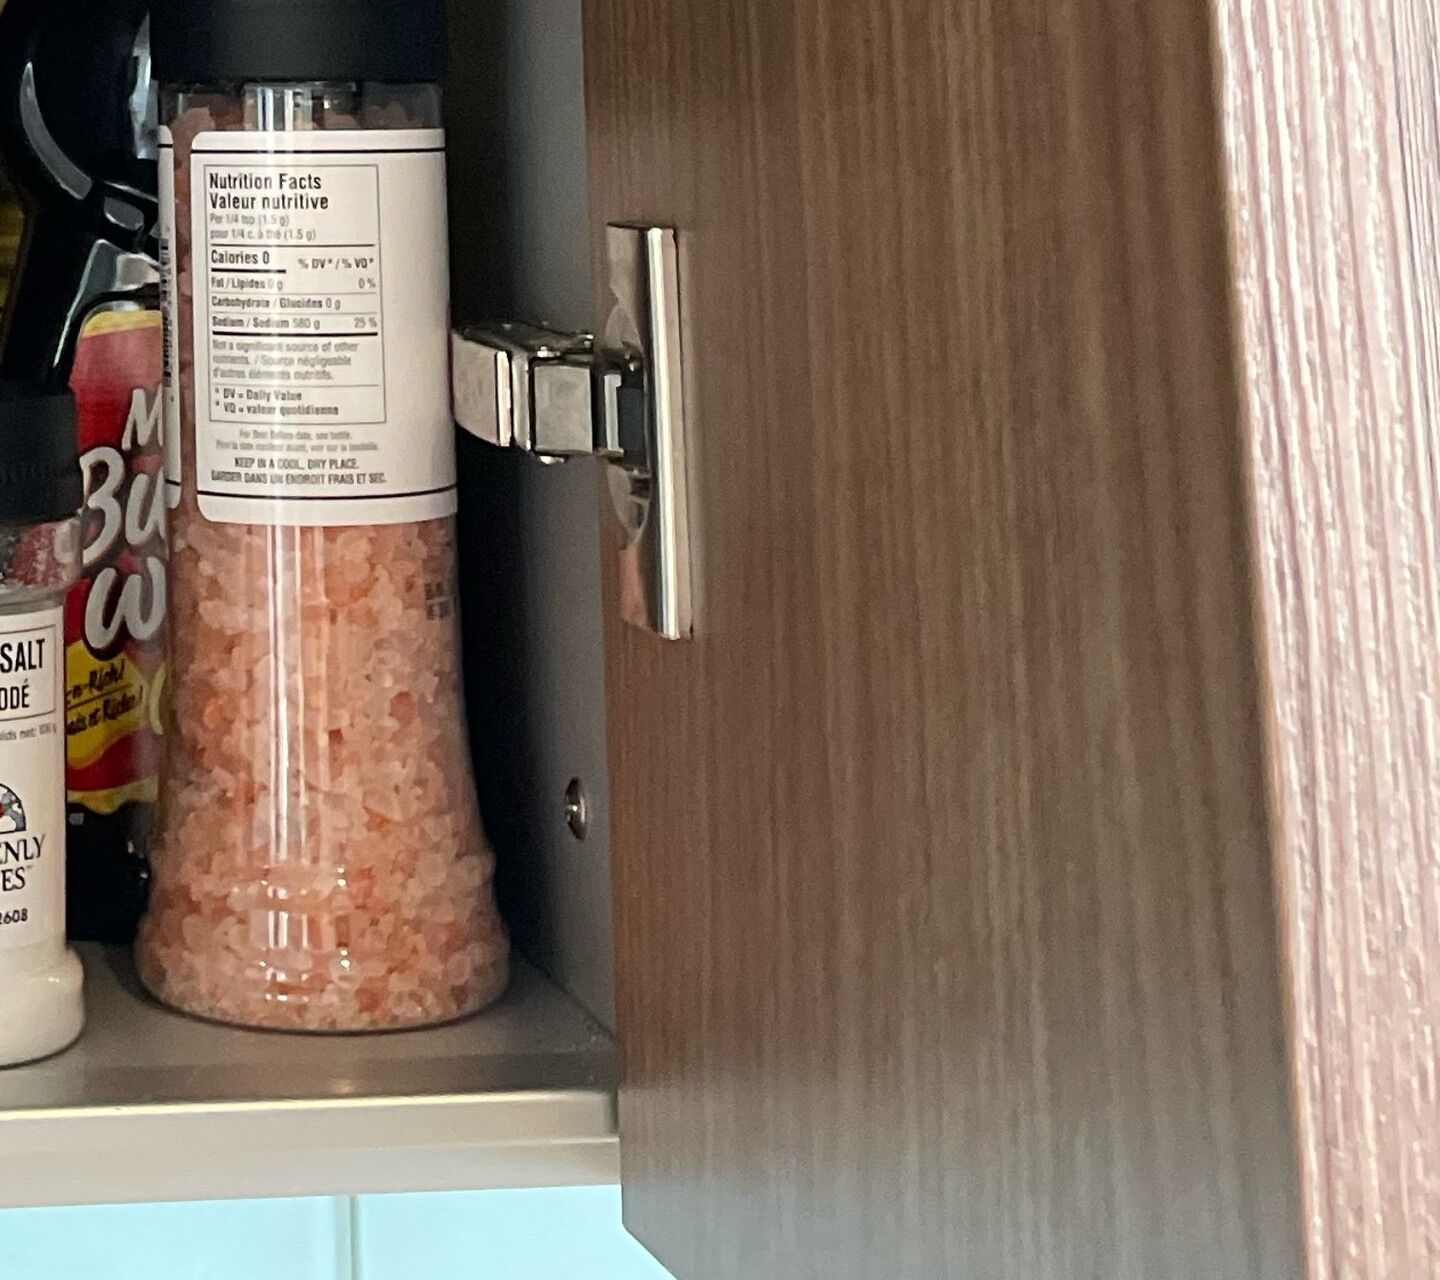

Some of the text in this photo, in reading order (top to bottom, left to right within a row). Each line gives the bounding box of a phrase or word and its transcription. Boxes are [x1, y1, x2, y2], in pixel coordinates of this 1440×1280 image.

[210, 173, 322, 189] Nutrition Facts
[210, 193, 329, 210] Valeur nutritive
[211, 250, 269, 264] Calories 0
[0, 638, 45, 673] SALT
